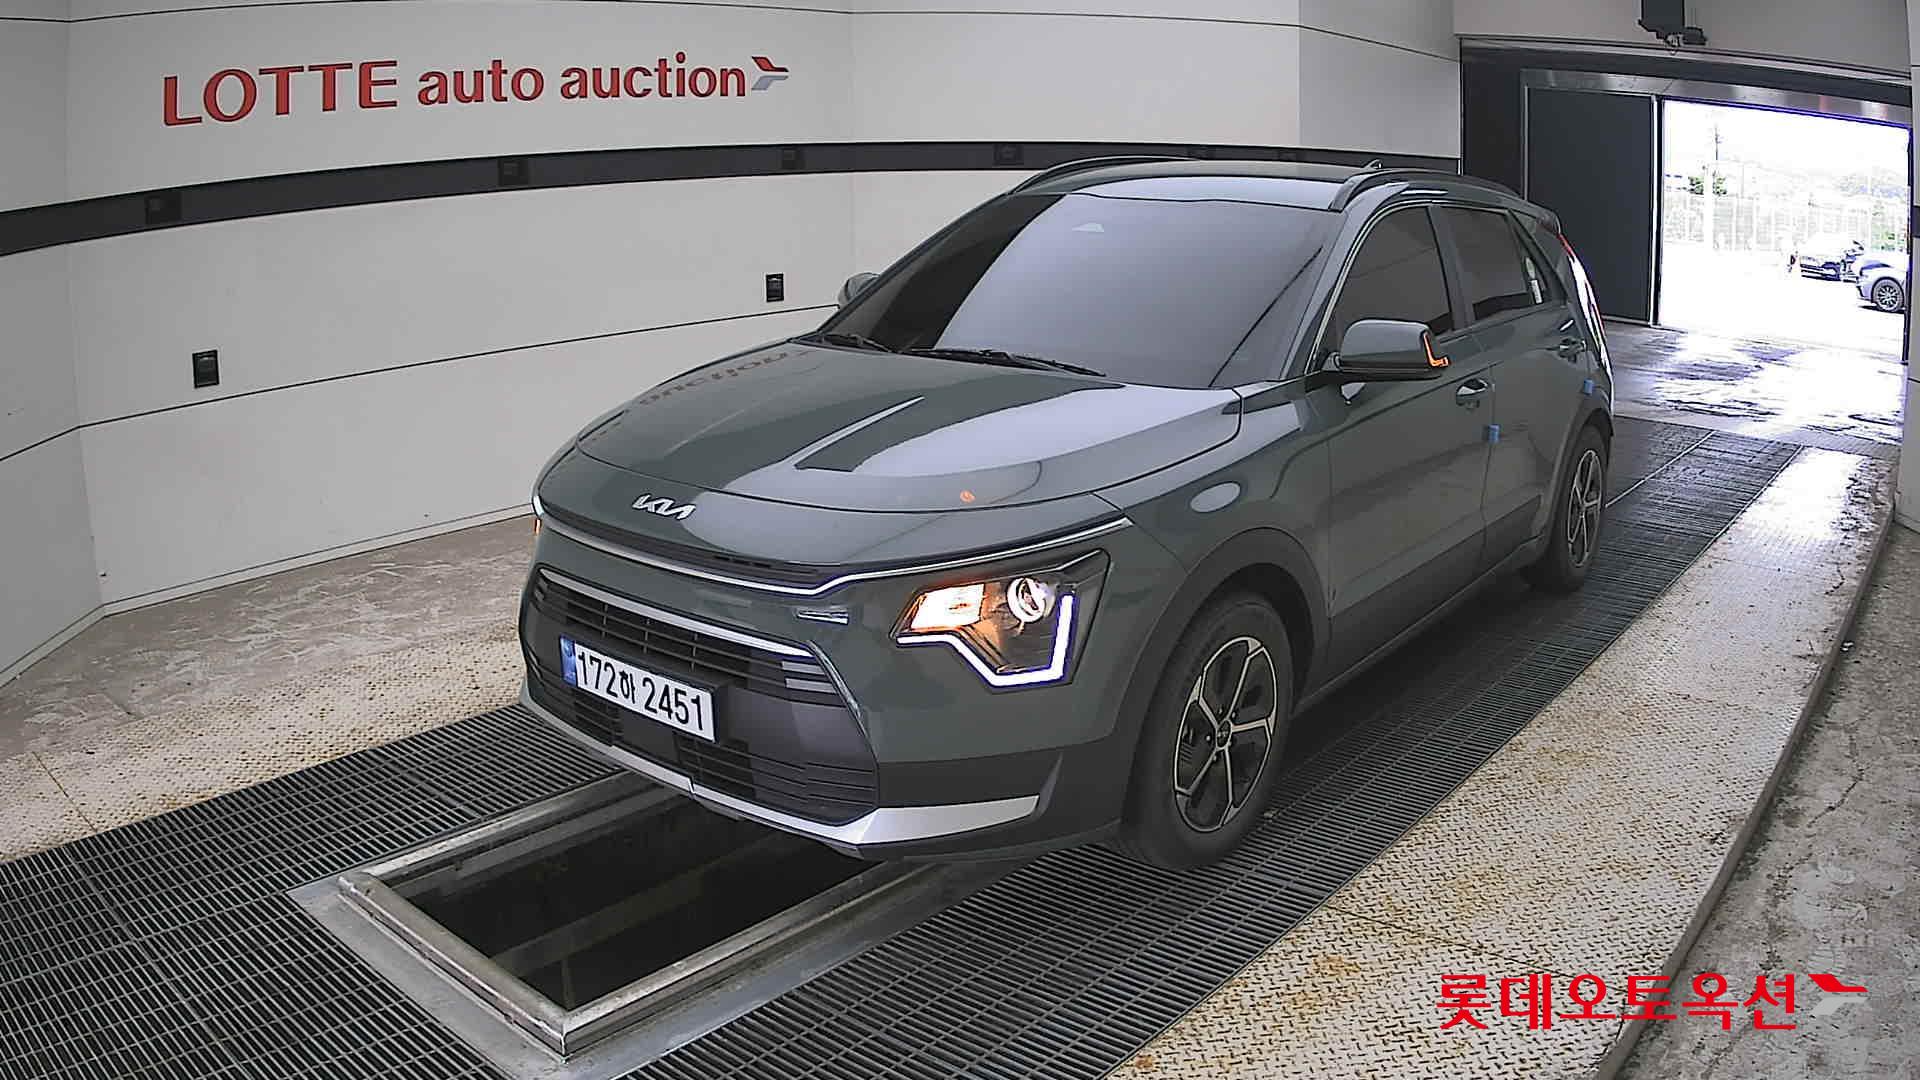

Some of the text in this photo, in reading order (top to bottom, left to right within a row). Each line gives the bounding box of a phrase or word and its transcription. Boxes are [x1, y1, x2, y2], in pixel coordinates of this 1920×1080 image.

[163, 51, 747, 127] LOTTE auto auction
[631, 493, 697, 520] KIA
